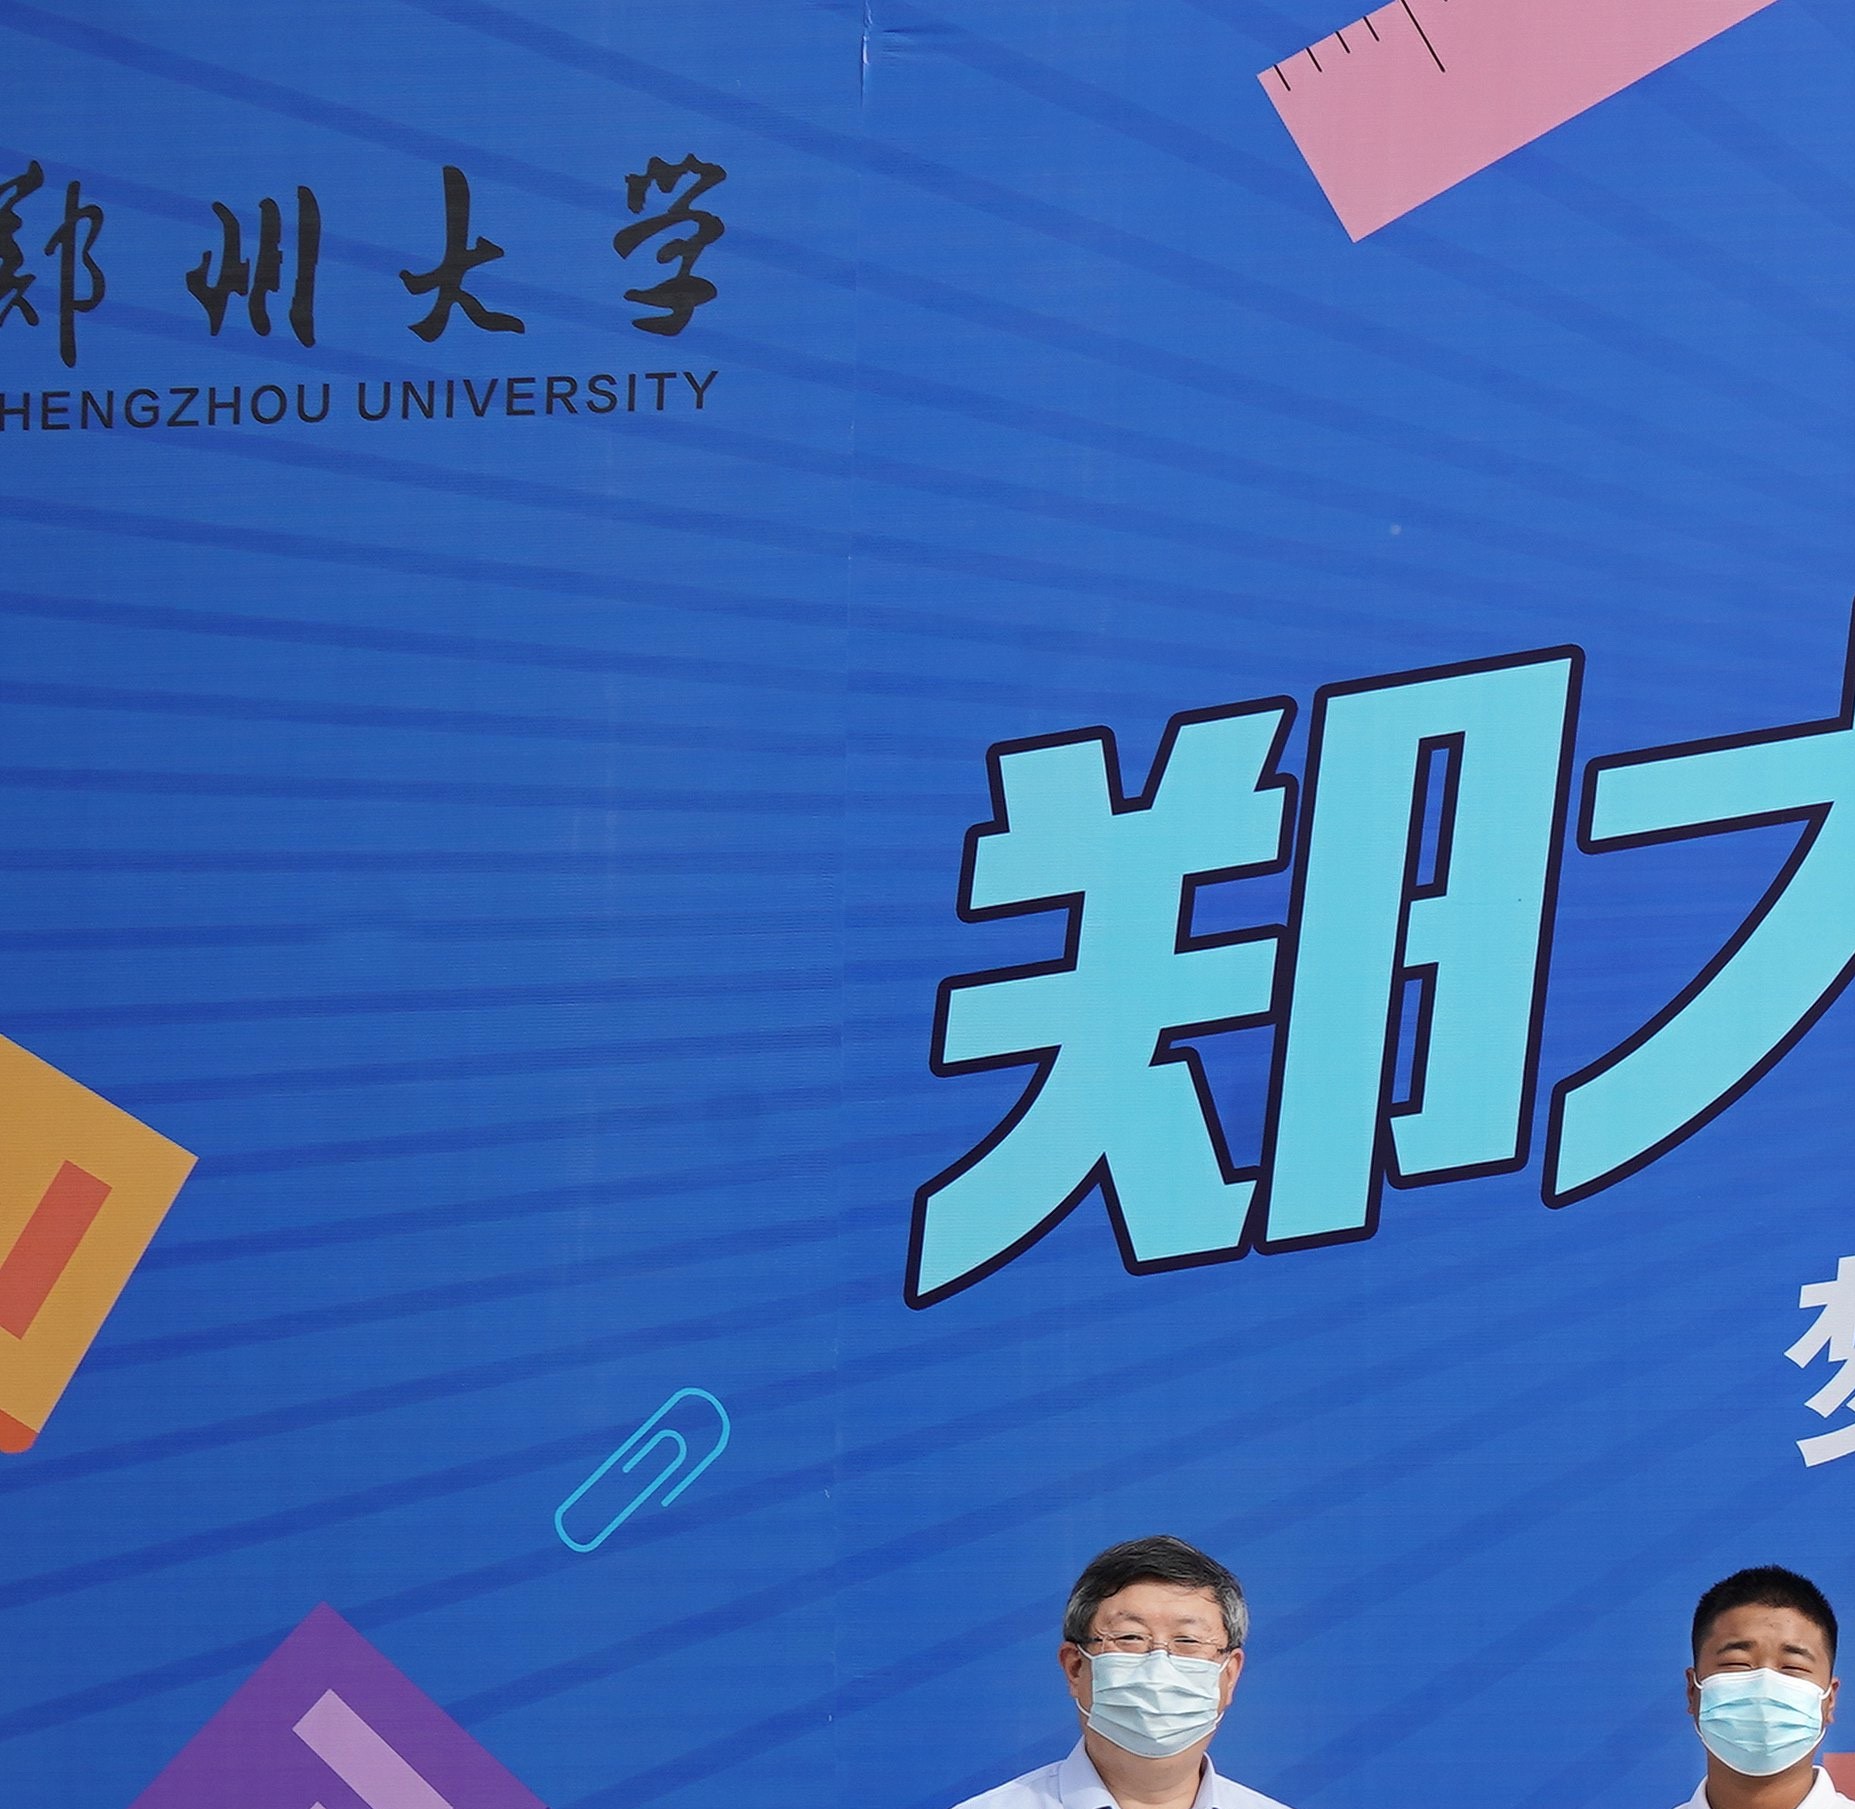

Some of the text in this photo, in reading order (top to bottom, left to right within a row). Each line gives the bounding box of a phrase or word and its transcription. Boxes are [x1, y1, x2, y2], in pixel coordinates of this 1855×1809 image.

[0, 153, 727, 368] 郑州大学
[358, 370, 719, 423] UNIVERSITY
